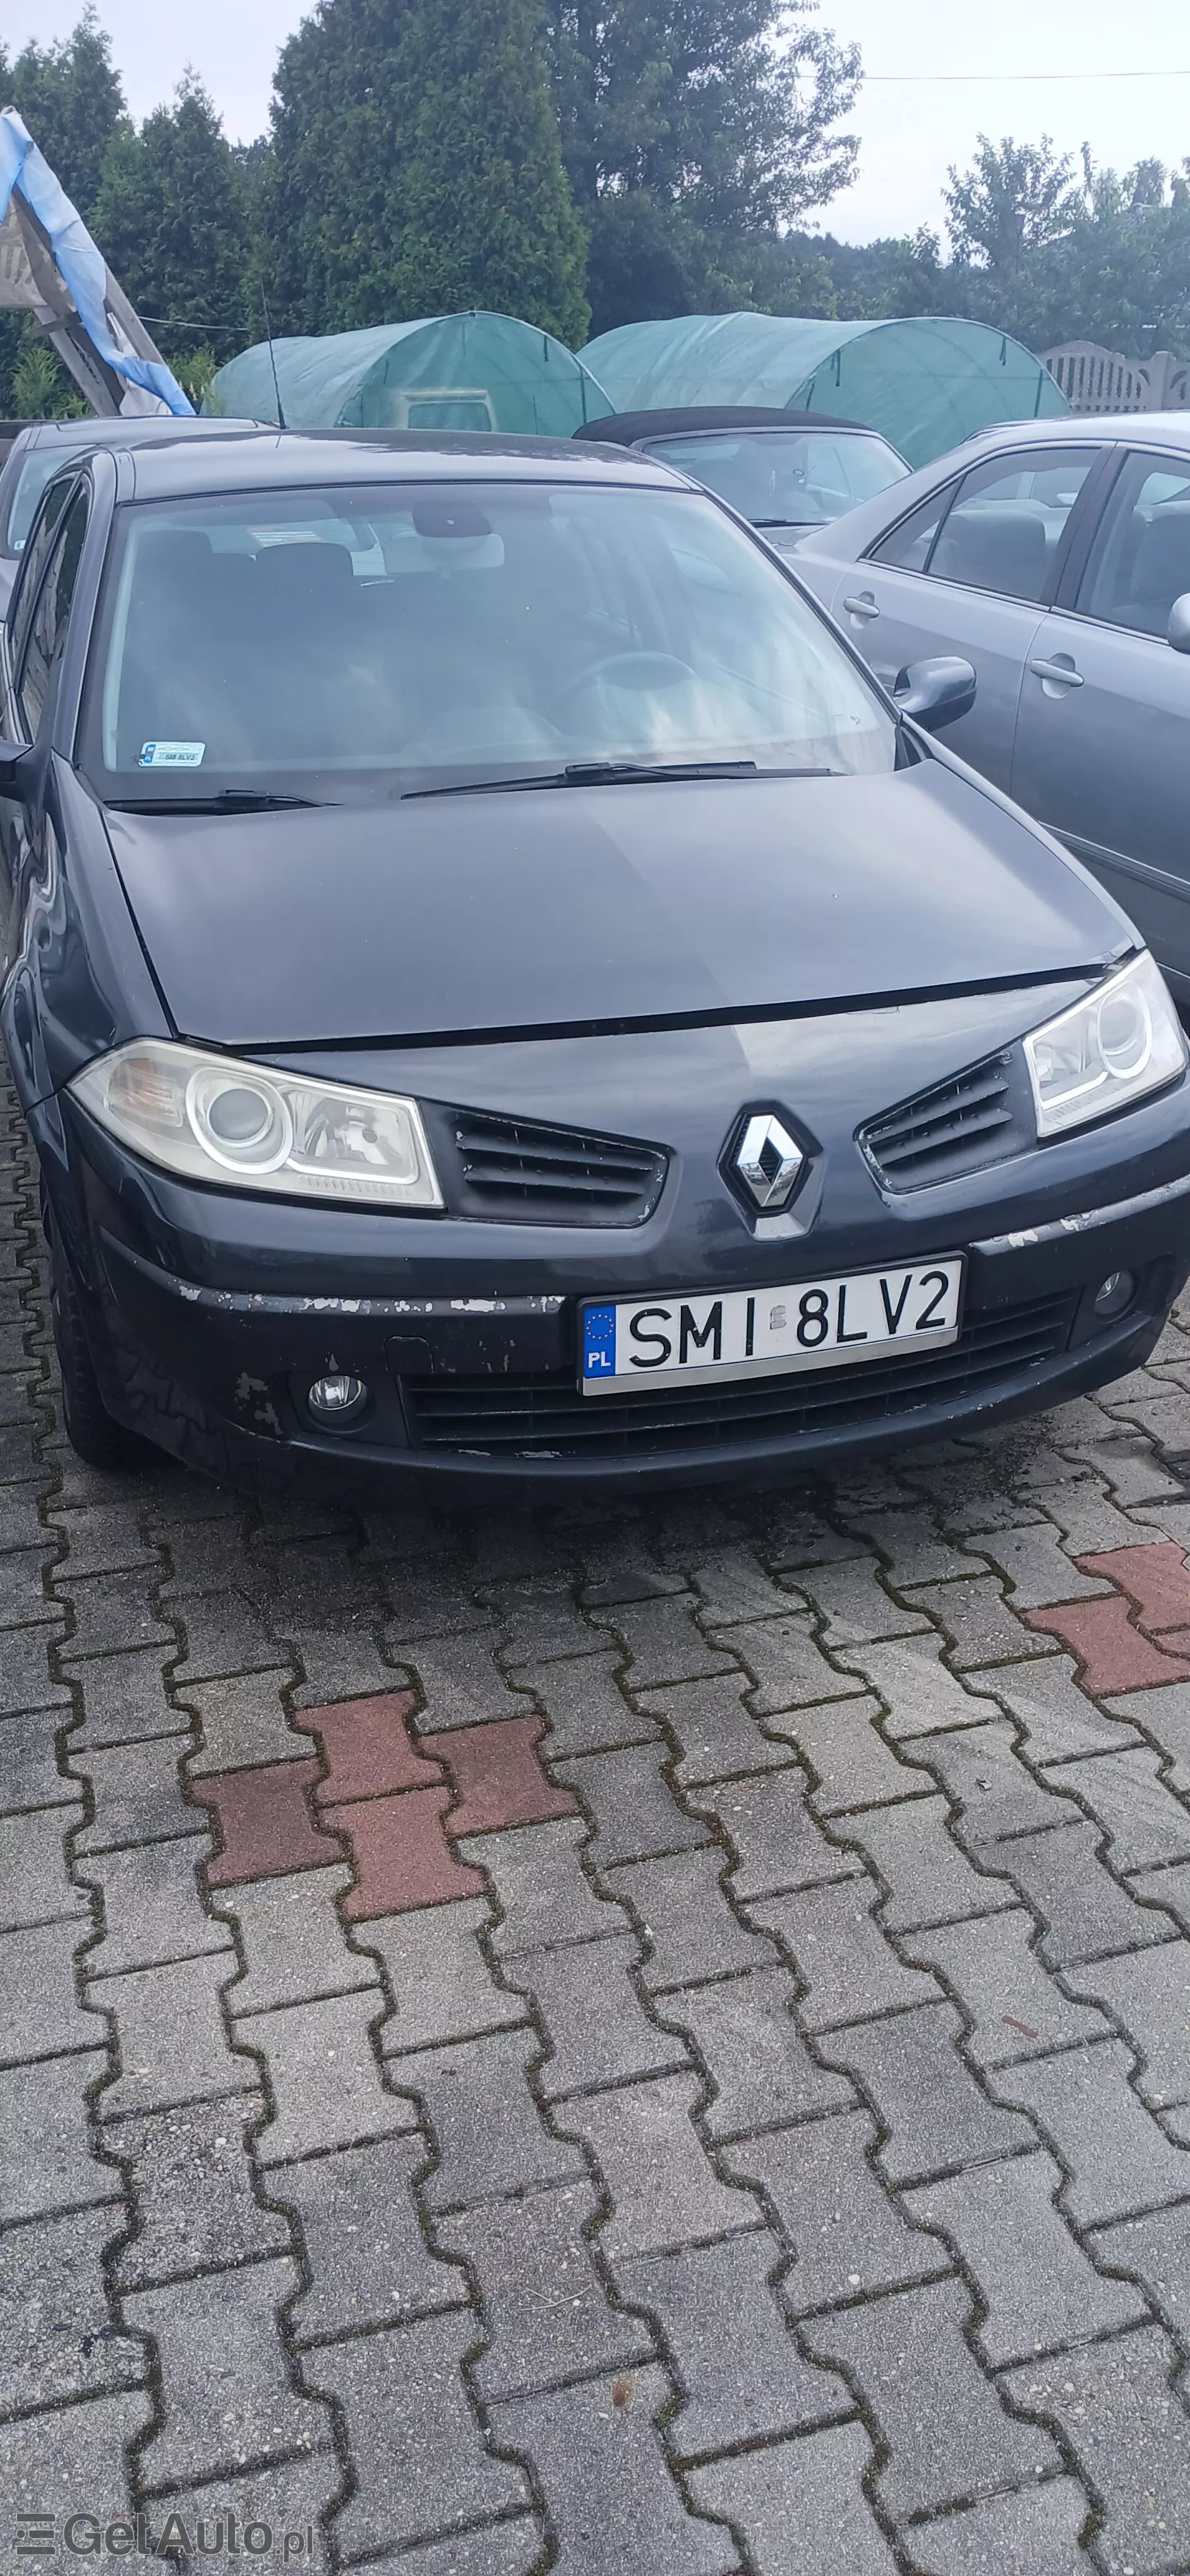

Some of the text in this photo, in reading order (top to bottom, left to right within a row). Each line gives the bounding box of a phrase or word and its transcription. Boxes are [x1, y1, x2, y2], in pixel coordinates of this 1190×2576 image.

[629, 1270, 949, 1368] SMI 8LV2
[587, 1352, 611, 1369] PL
